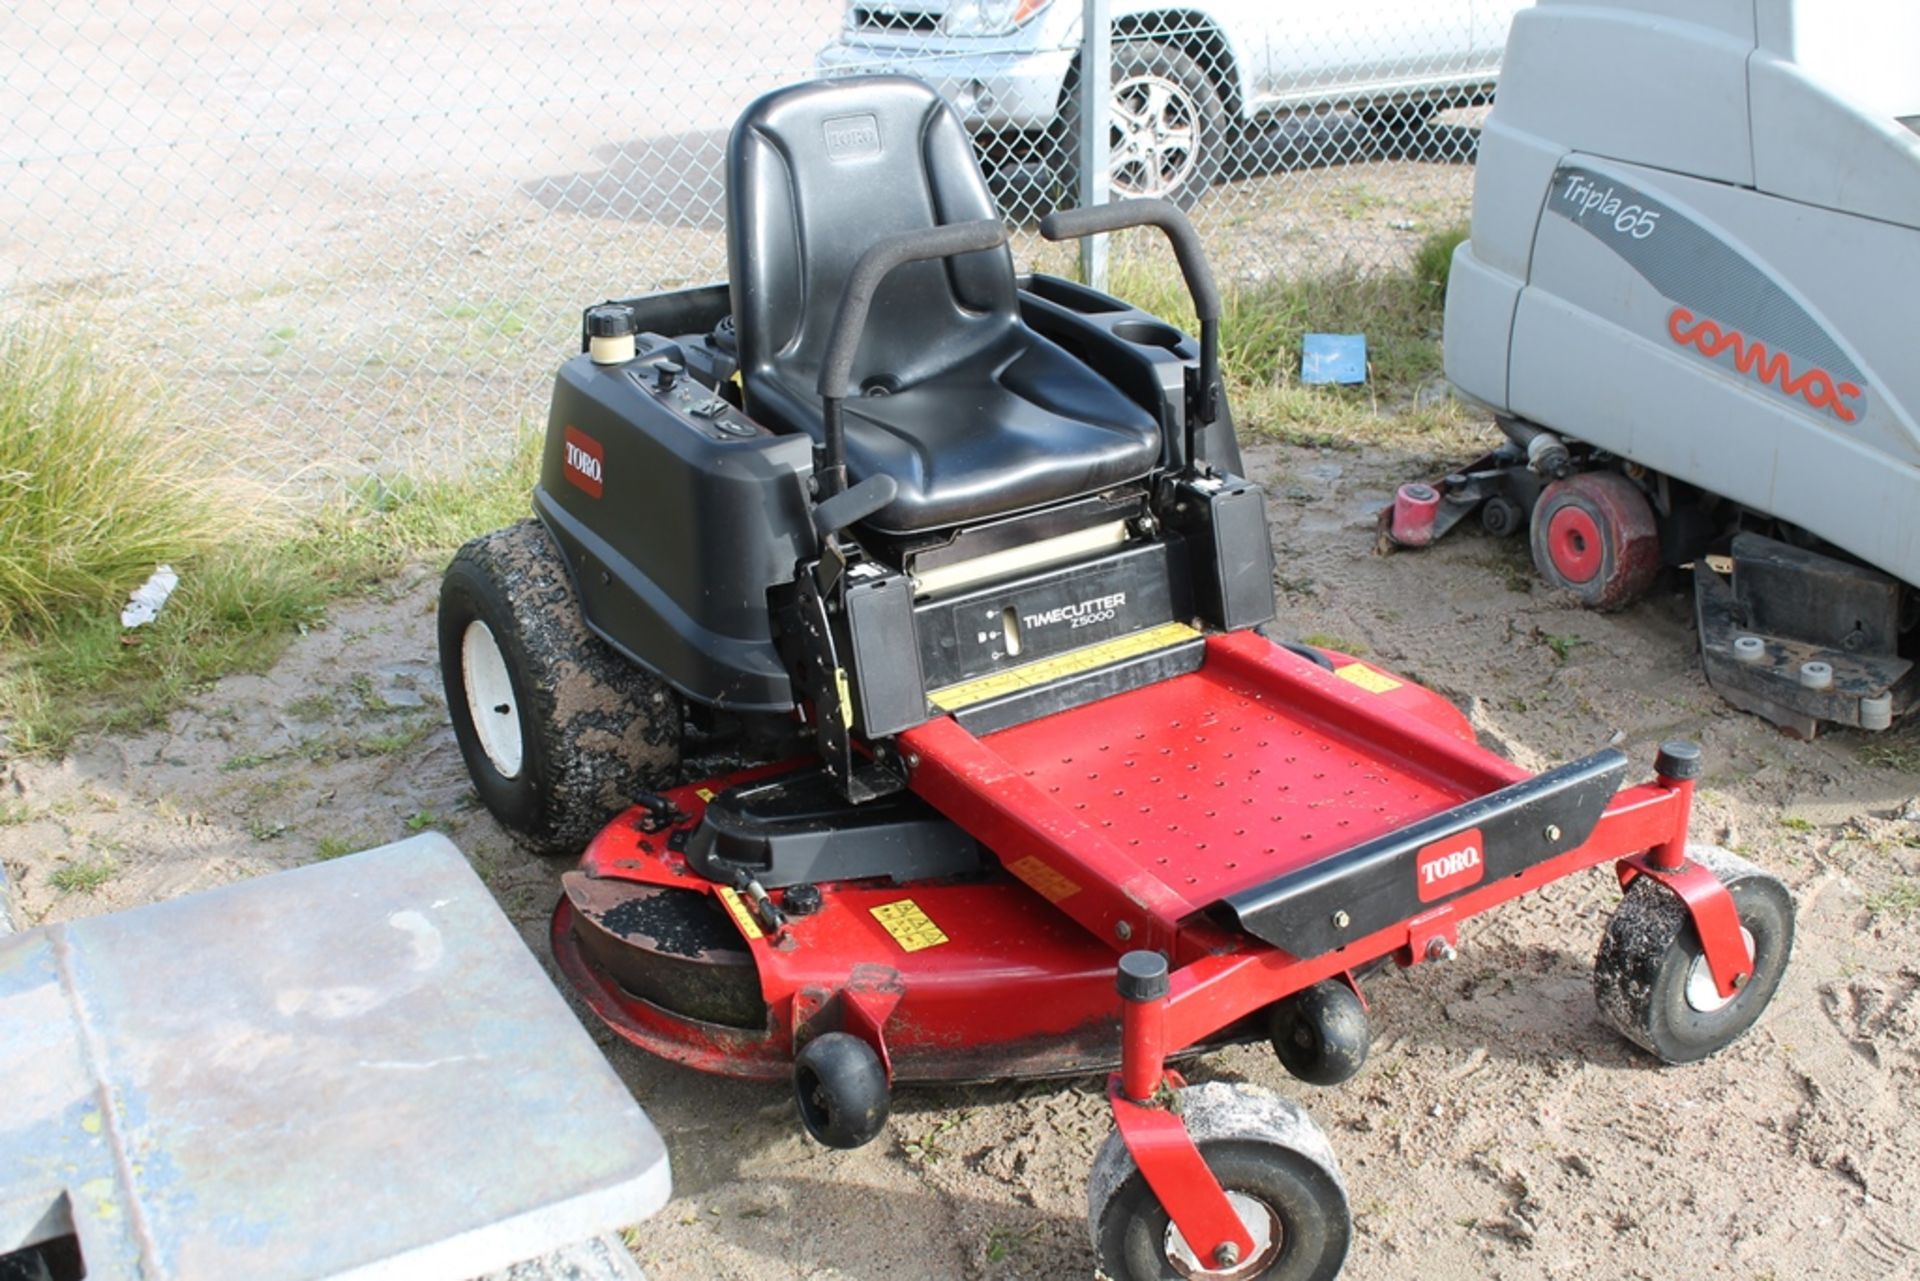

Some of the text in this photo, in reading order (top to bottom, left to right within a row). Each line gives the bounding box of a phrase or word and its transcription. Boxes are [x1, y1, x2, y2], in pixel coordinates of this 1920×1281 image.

[566, 441, 602, 482] TORO
[1023, 592, 1126, 629] TIMECUTTER
[1071, 608, 1115, 629] Z5000
[1421, 846, 1480, 885] TORO
